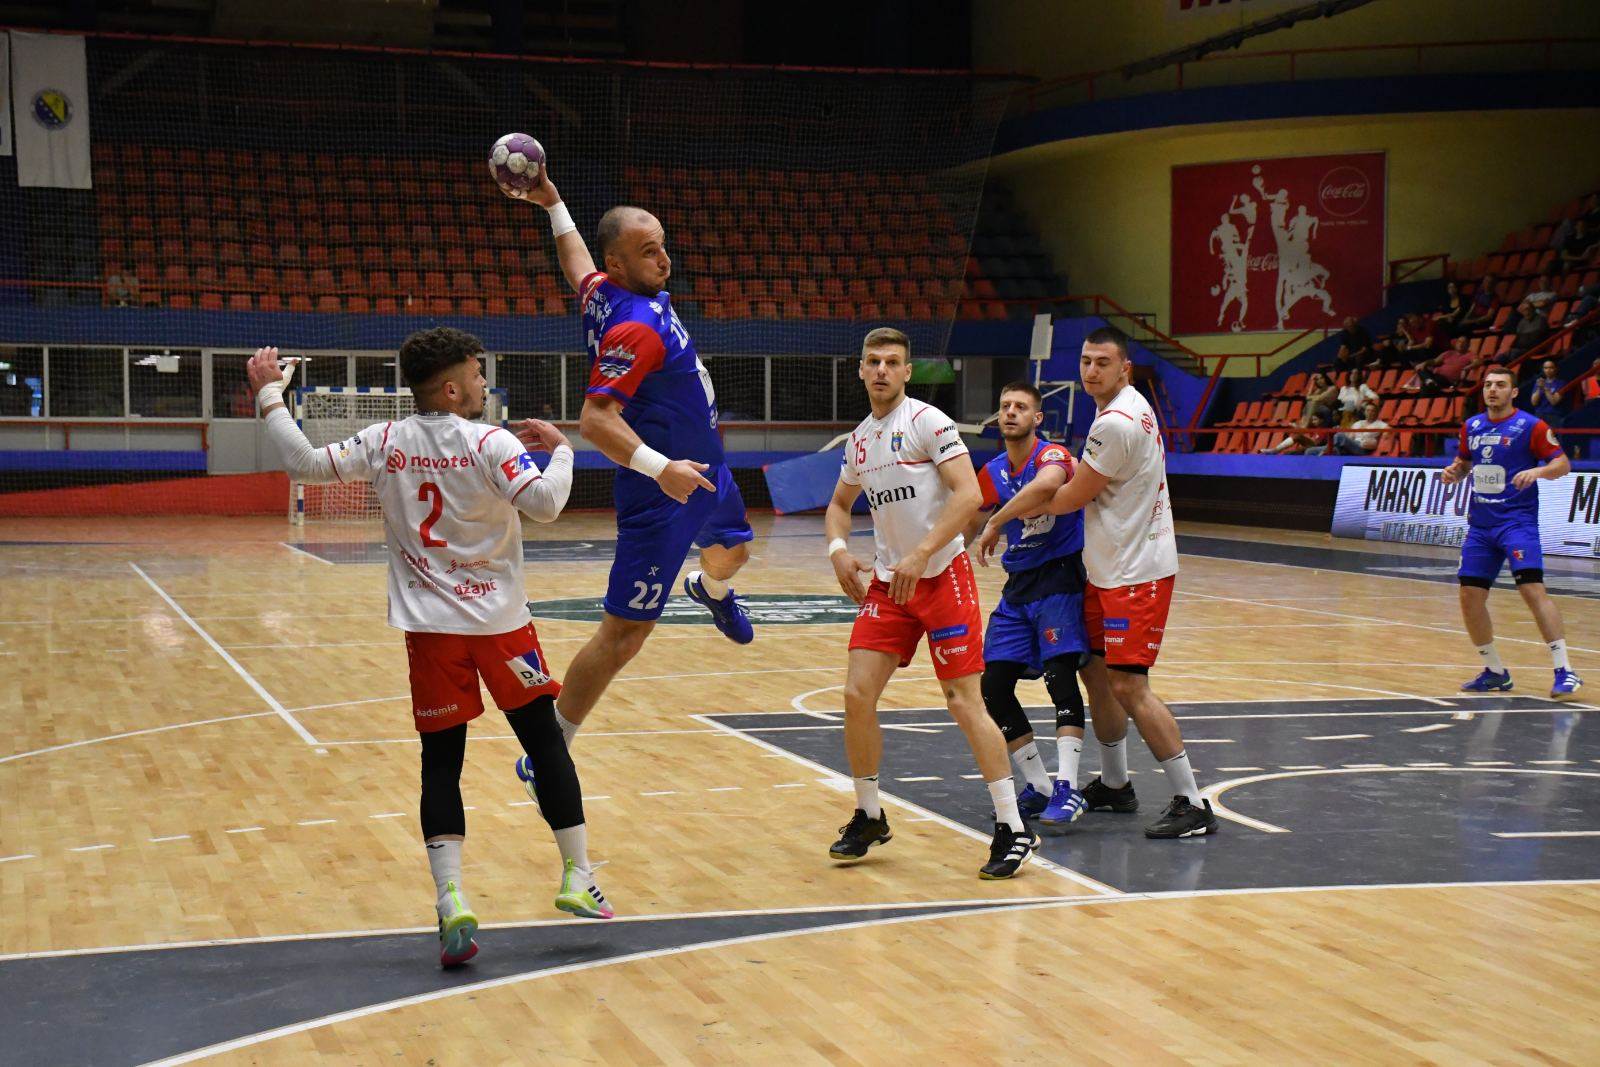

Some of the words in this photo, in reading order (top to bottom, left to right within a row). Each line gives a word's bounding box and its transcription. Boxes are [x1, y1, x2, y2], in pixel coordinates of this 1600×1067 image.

[1321, 183, 1366, 200] Coca-Cola
[854, 437, 867, 467] 15
[1467, 435, 1481, 451] 18
[410, 451, 476, 469] novotel
[1364, 469, 1427, 515] МАКО
[418, 481, 448, 548] 2
[454, 576, 497, 596] džajić
[627, 580, 664, 610] 22
